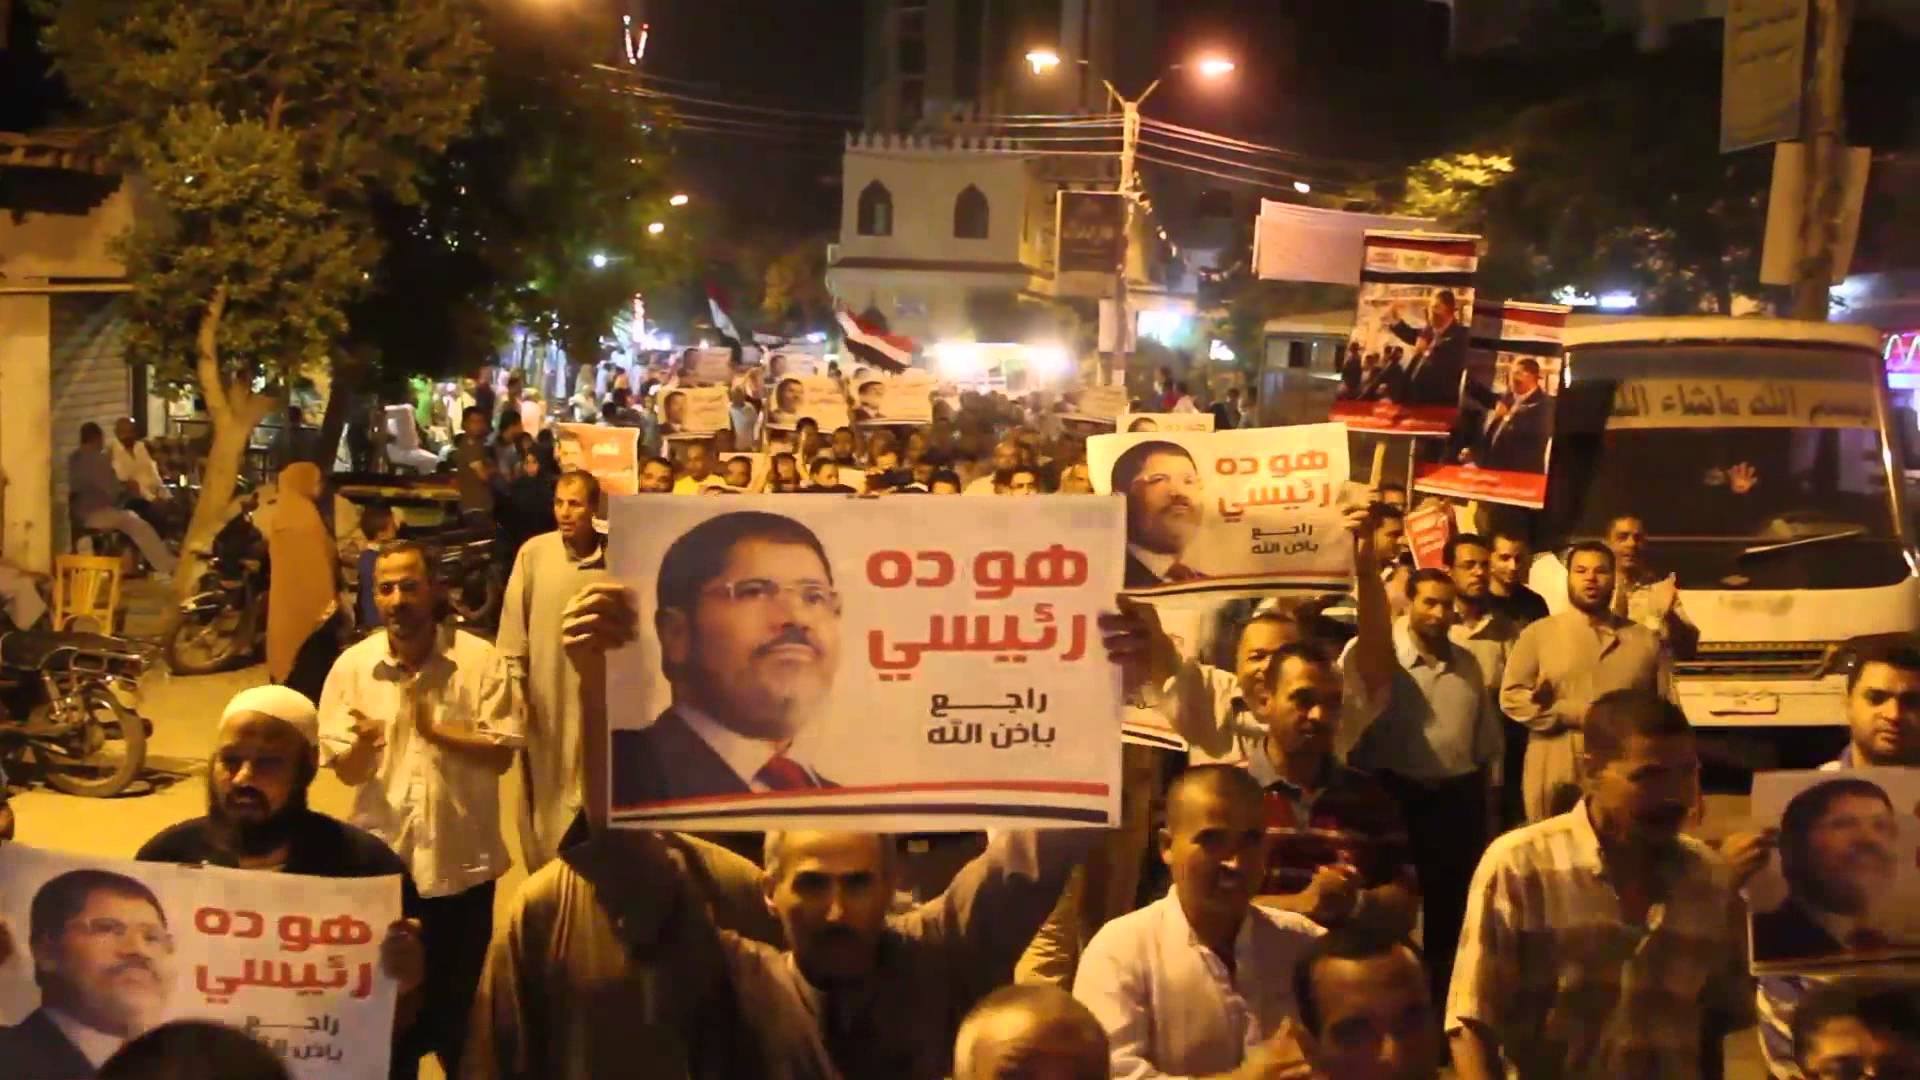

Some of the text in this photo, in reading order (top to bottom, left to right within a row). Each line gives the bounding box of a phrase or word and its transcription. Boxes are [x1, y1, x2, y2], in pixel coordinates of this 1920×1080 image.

[1215, 449, 1329, 479] هو ده
[1217, 478, 1330, 524] رئيسي
[1250, 540, 1281, 555] الله
[866, 543, 1089, 600] هو ده
[867, 602, 1088, 682] رئيسي
[927, 718, 983, 745] الله
[194, 906, 373, 953] هو ده
[195, 953, 373, 1005] رئيسي
